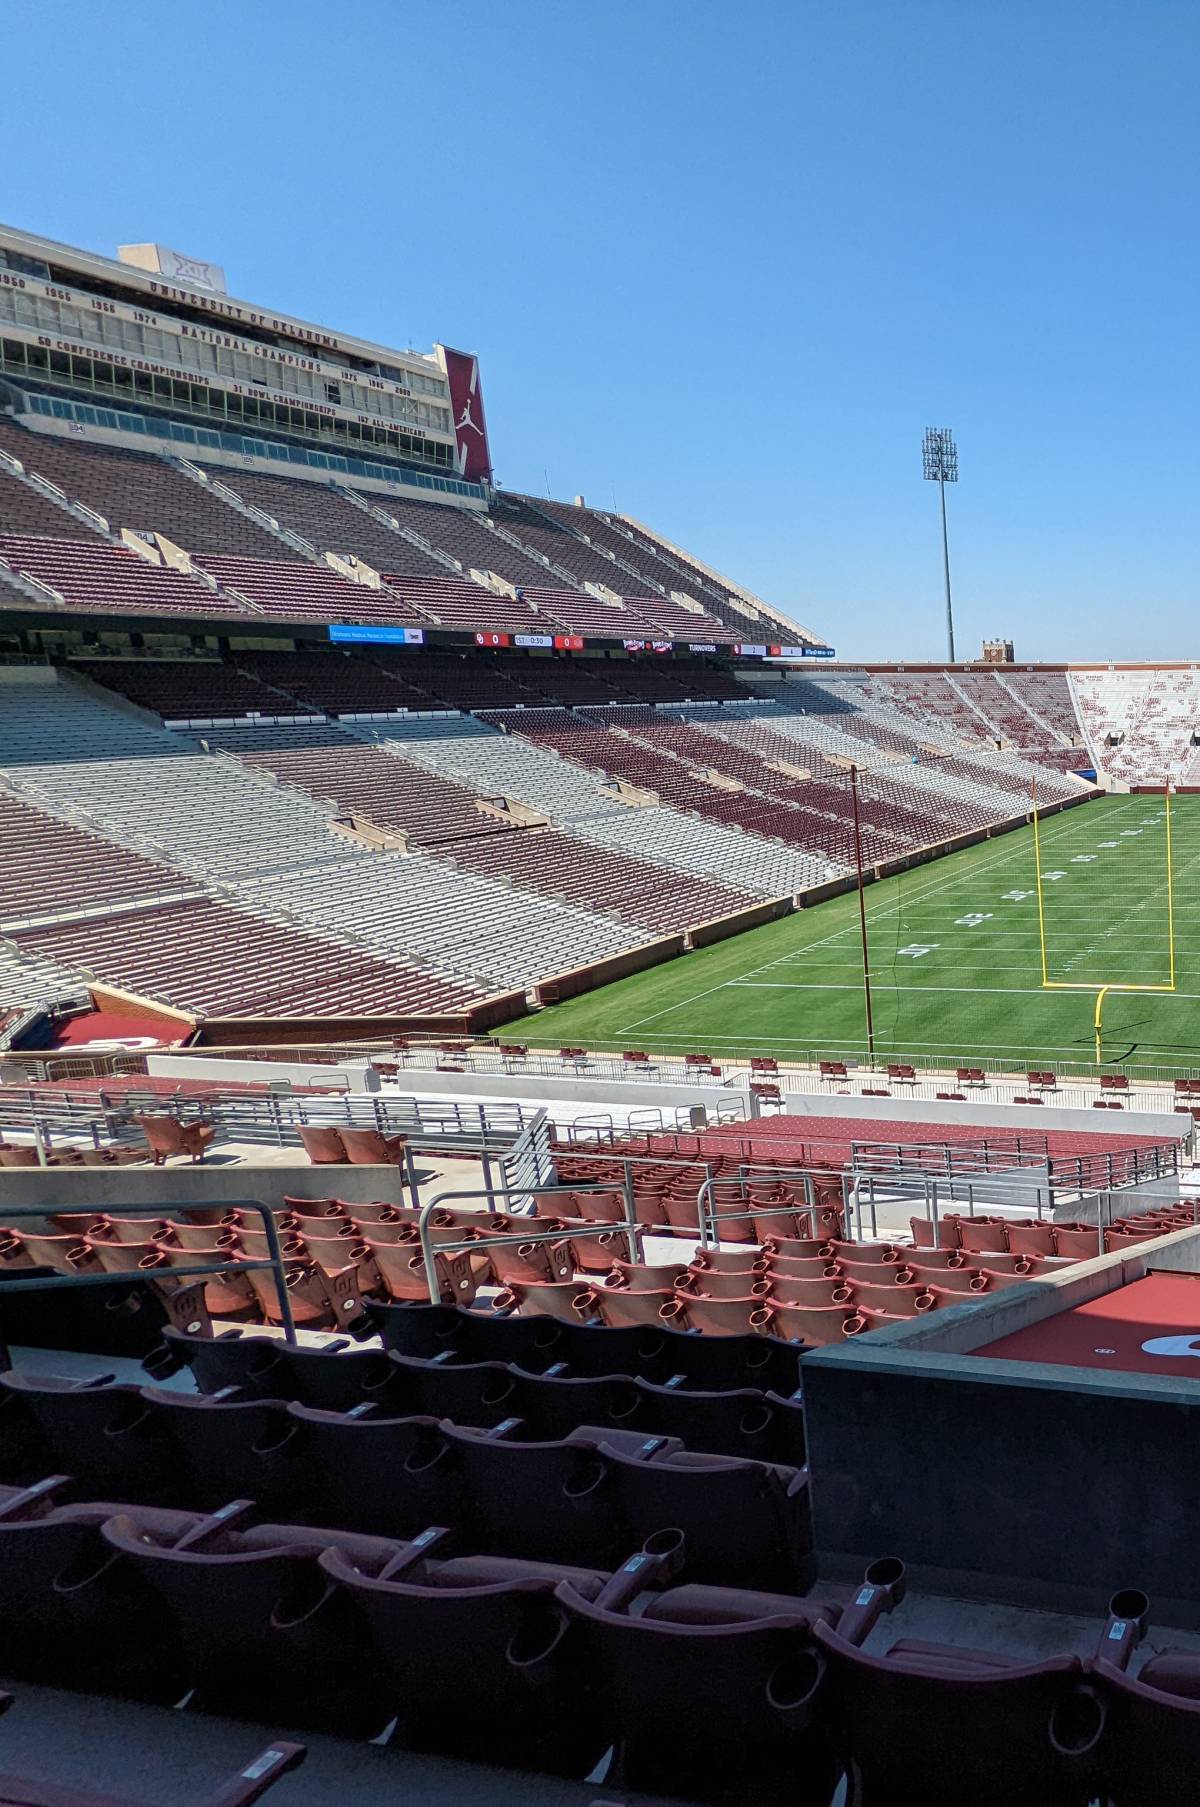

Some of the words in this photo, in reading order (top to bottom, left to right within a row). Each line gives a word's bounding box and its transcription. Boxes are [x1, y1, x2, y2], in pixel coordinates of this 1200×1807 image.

[134, 311, 157, 326] 1974
[150, 281, 242, 319] UNIVERSITY
[251, 313, 265, 327] OF
[272, 319, 339, 349] OKLAHOMA
[181, 324, 248, 353] NATIONAL
[254, 346, 321, 373] CHAMPIONS
[57, 340, 127, 366] CONFERENCE
[131, 358, 210, 386] CHAMPIONSHIPS
[248, 388, 271, 401] BOWL
[273, 393, 337, 417] CHAMPIONSHIPS
[373, 419, 427, 438] ALL-AMERICANS
[688, 643, 717, 652] TURNOVERS
[954, 913, 994, 926] 20
[896, 944, 941, 956] 10
